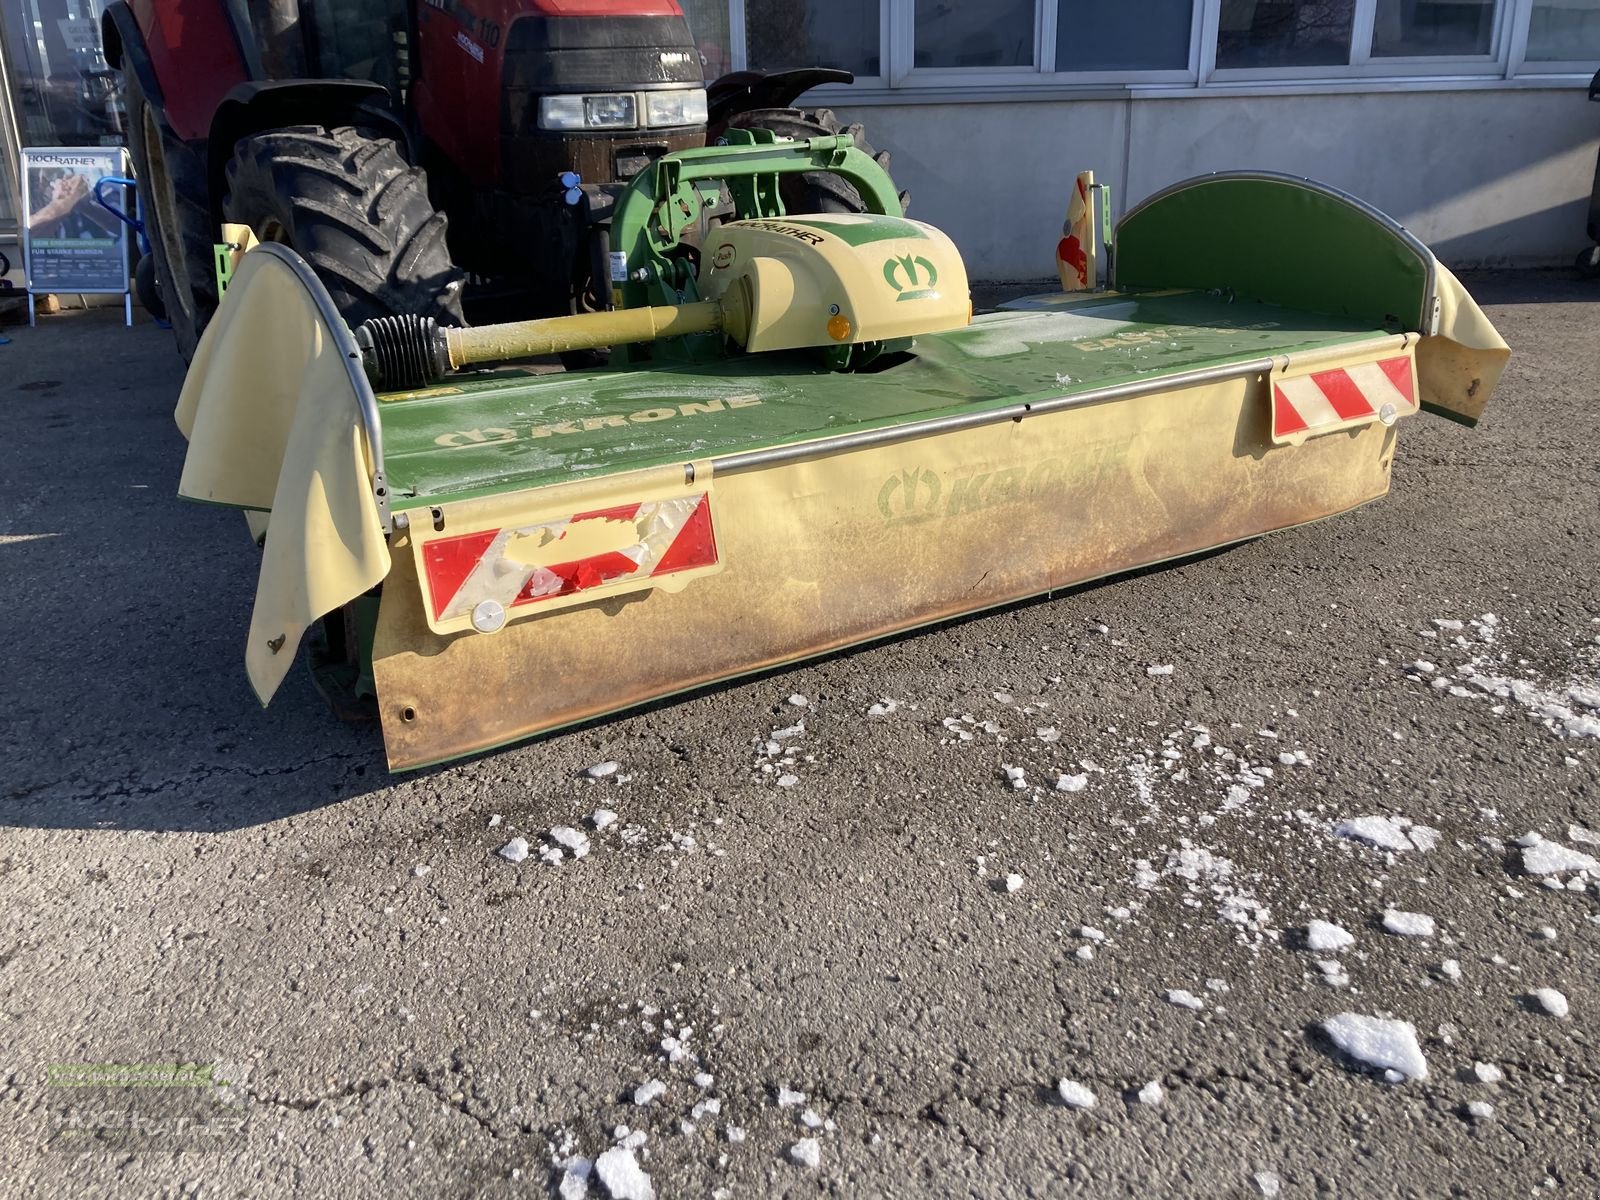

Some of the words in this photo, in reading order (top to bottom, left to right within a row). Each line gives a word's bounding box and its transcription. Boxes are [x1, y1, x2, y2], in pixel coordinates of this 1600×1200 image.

[480, 18, 500, 49] 110
[28, 155, 95, 165] HOCHRATHER
[531, 394, 763, 438] KRONE
